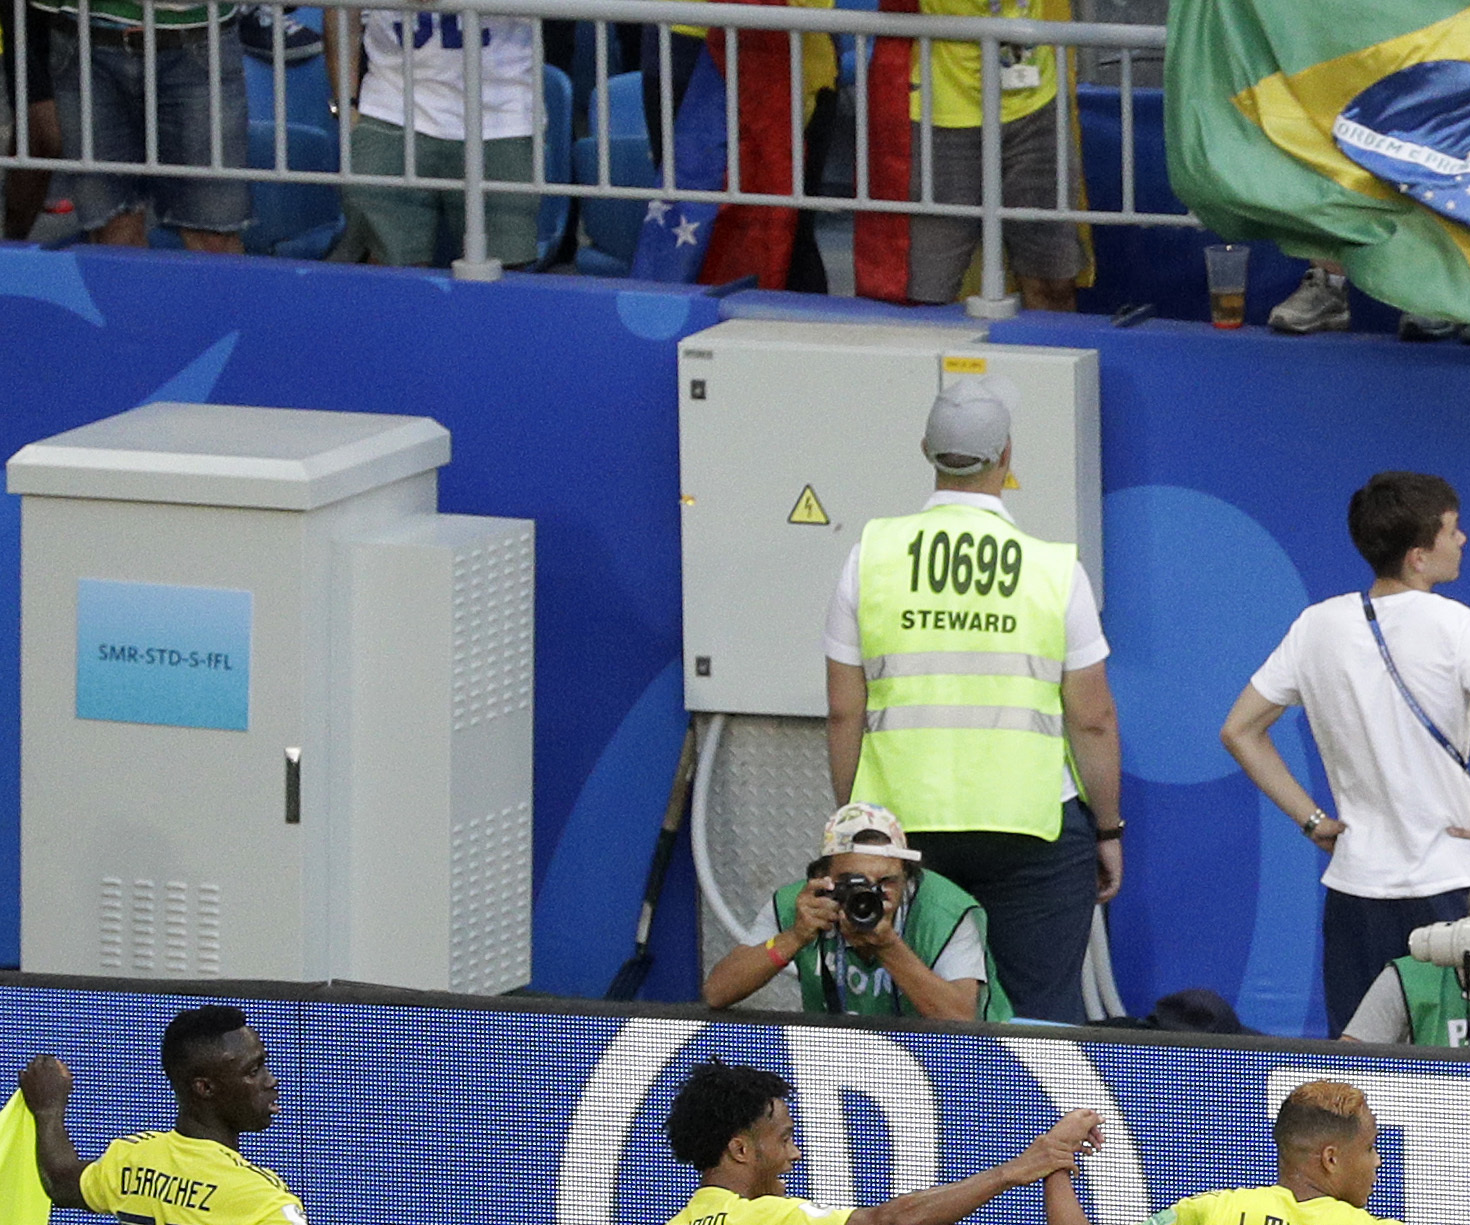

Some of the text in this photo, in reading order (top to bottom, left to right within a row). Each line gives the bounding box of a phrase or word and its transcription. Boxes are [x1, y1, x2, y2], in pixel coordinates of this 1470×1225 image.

[1337, 122, 1402, 155] ORDEM
[907, 529, 1023, 599] 10699
[900, 609, 1018, 634] STEWARD
